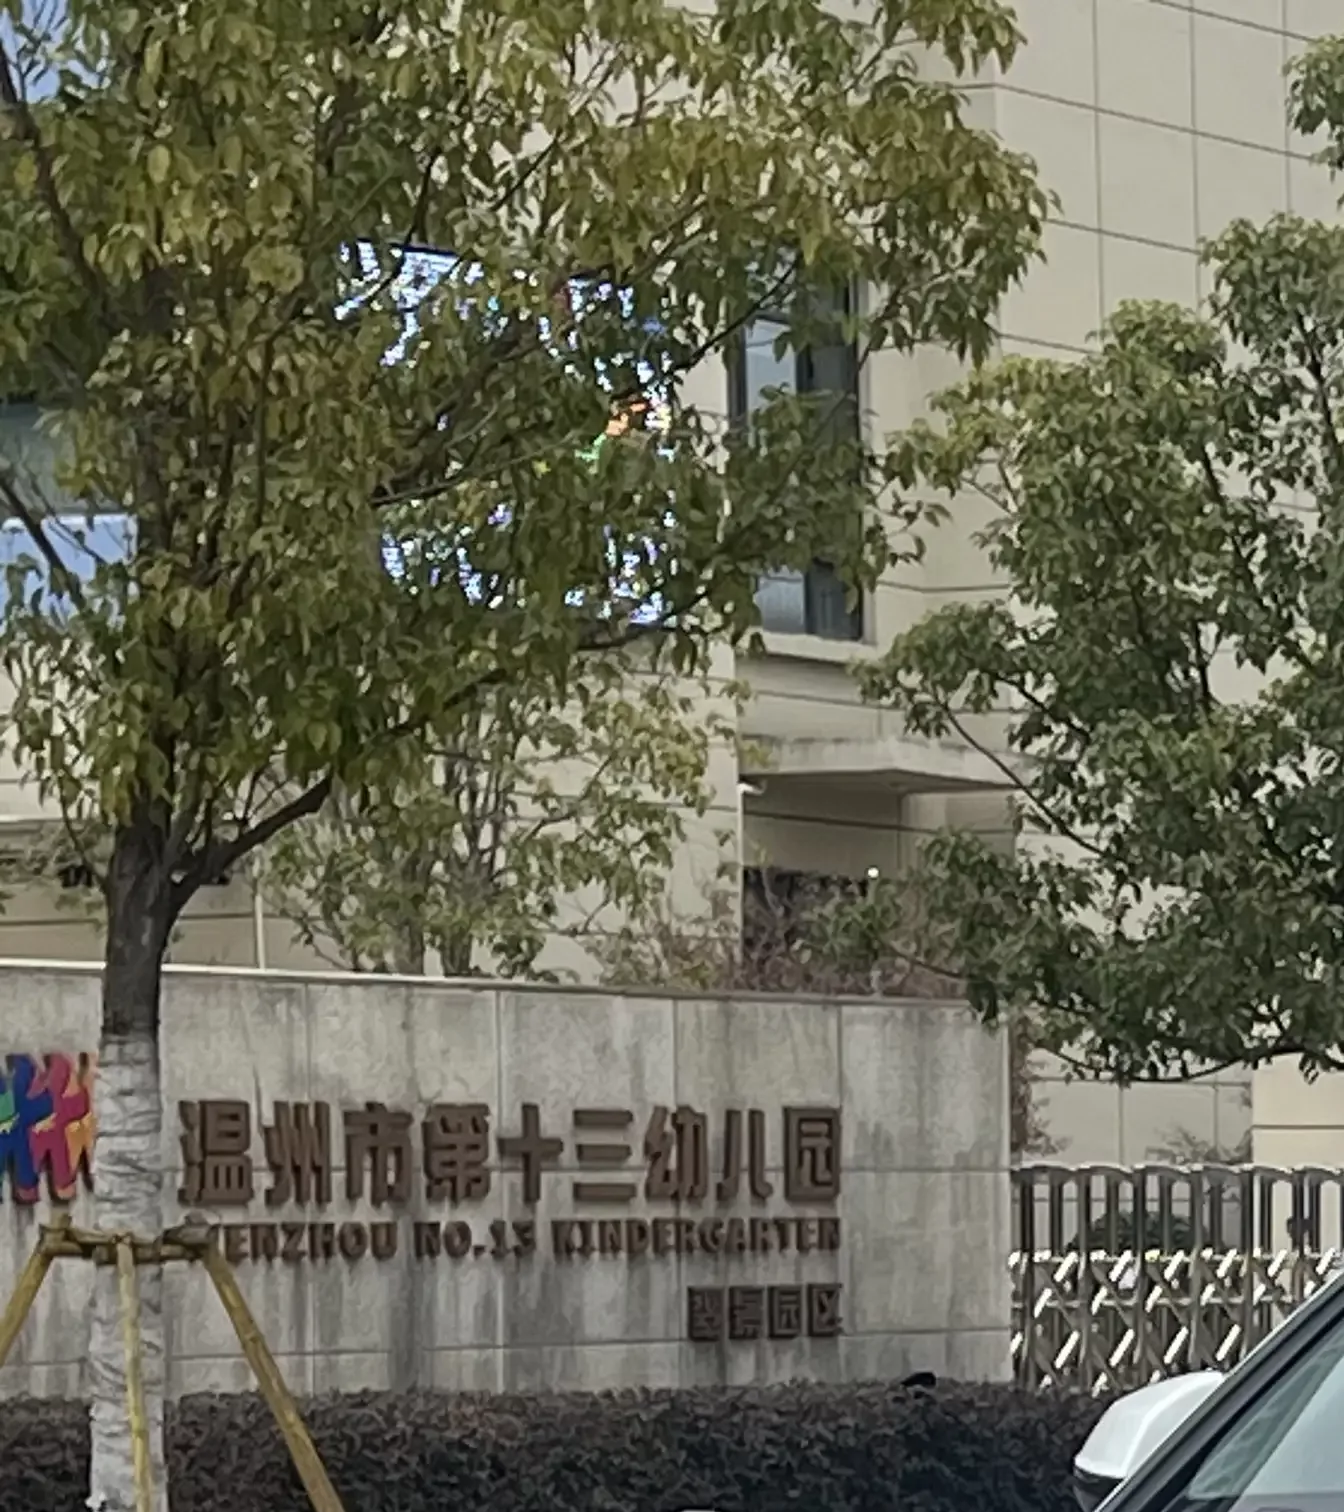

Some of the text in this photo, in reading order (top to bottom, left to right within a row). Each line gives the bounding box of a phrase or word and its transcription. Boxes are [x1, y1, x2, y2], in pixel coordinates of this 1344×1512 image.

[177, 1100, 842, 1206] 温州市第十三幼儿园
[205, 1222, 398, 1260] ENZHOU
[551, 1217, 842, 1257] KINDERGARTEN
